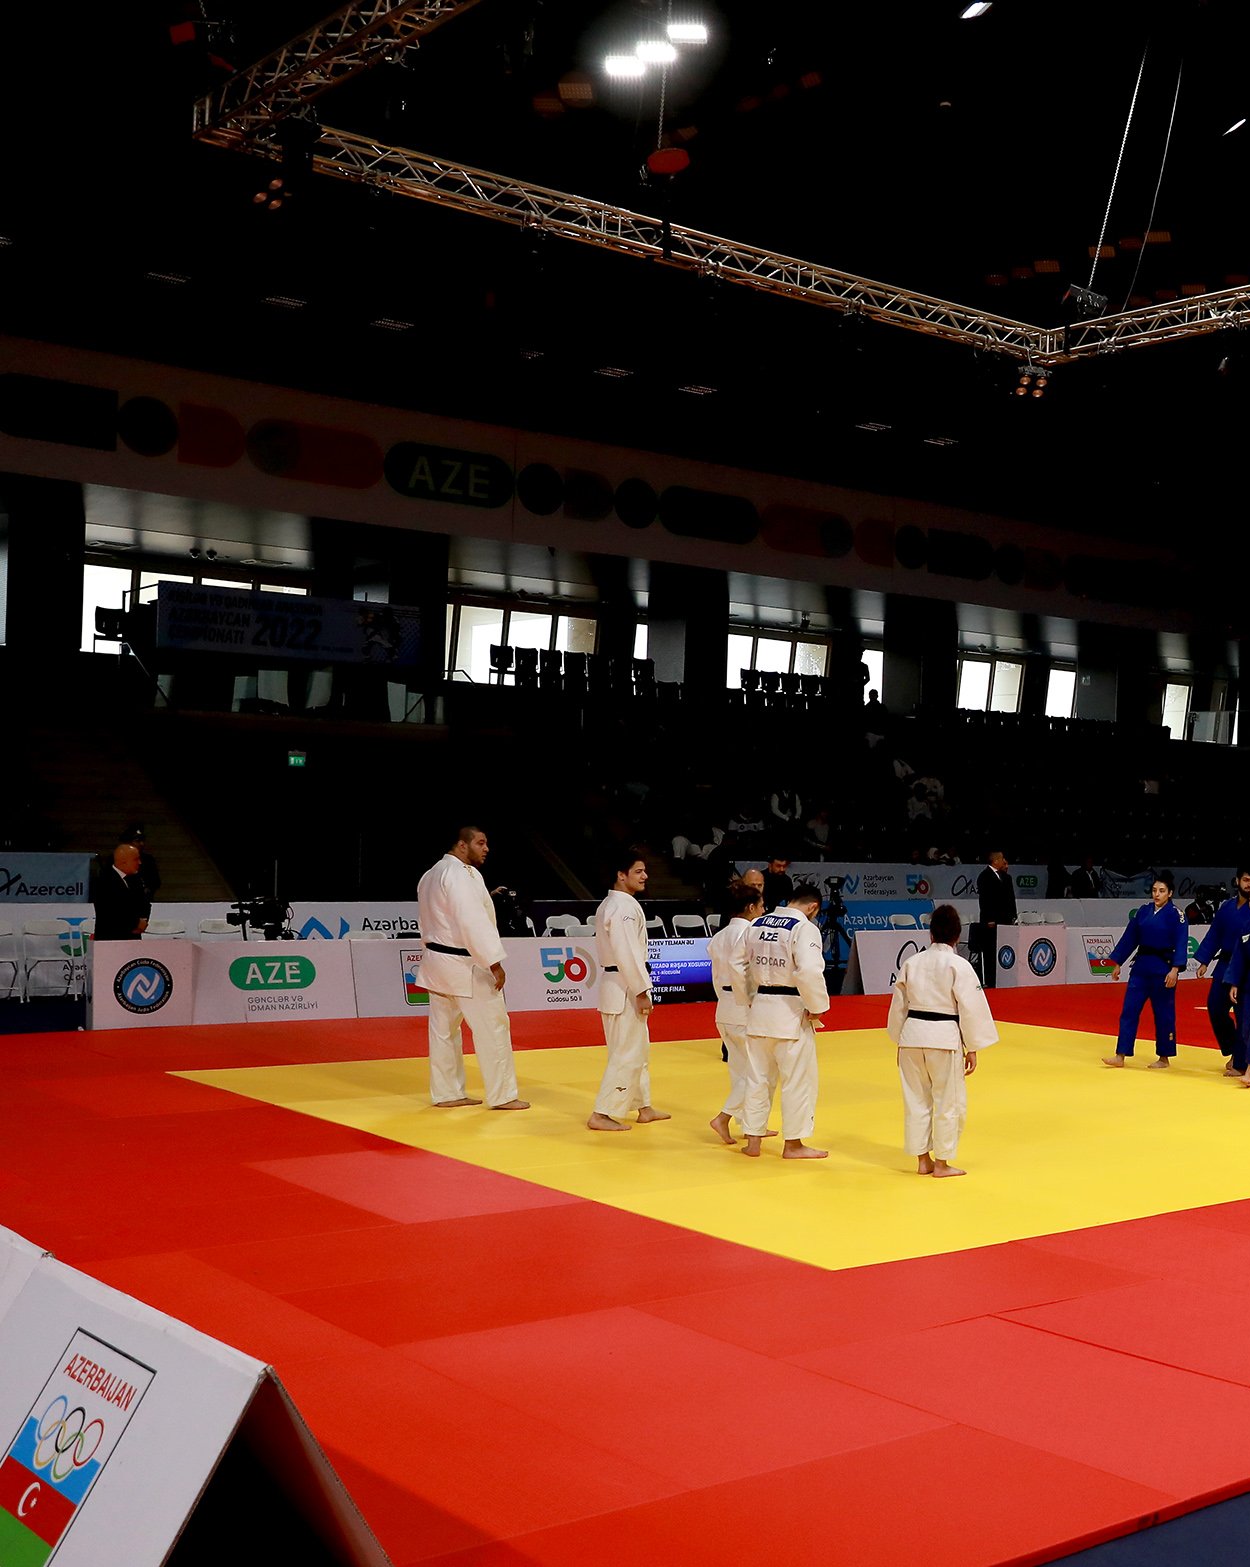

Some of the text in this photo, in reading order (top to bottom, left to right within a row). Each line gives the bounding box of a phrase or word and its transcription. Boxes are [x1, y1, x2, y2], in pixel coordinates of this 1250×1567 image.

[408, 455, 491, 500] AZE
[252, 615, 322, 648] 2022
[16, 882, 84, 896] Azercell
[1019, 878, 1034, 886] AZE
[362, 916, 419, 931] Azərba
[843, 914, 889, 928] Azərbay
[759, 931, 778, 941] AZE
[756, 955, 786, 968] SOCAR
[245, 962, 301, 985] AZE
[247, 995, 304, 1004] GƏNCLƏR VƏ
[279, 1001, 319, 1011] NAZİRLİYİ
[63, 1353, 138, 1411] AZERBAIJAN
